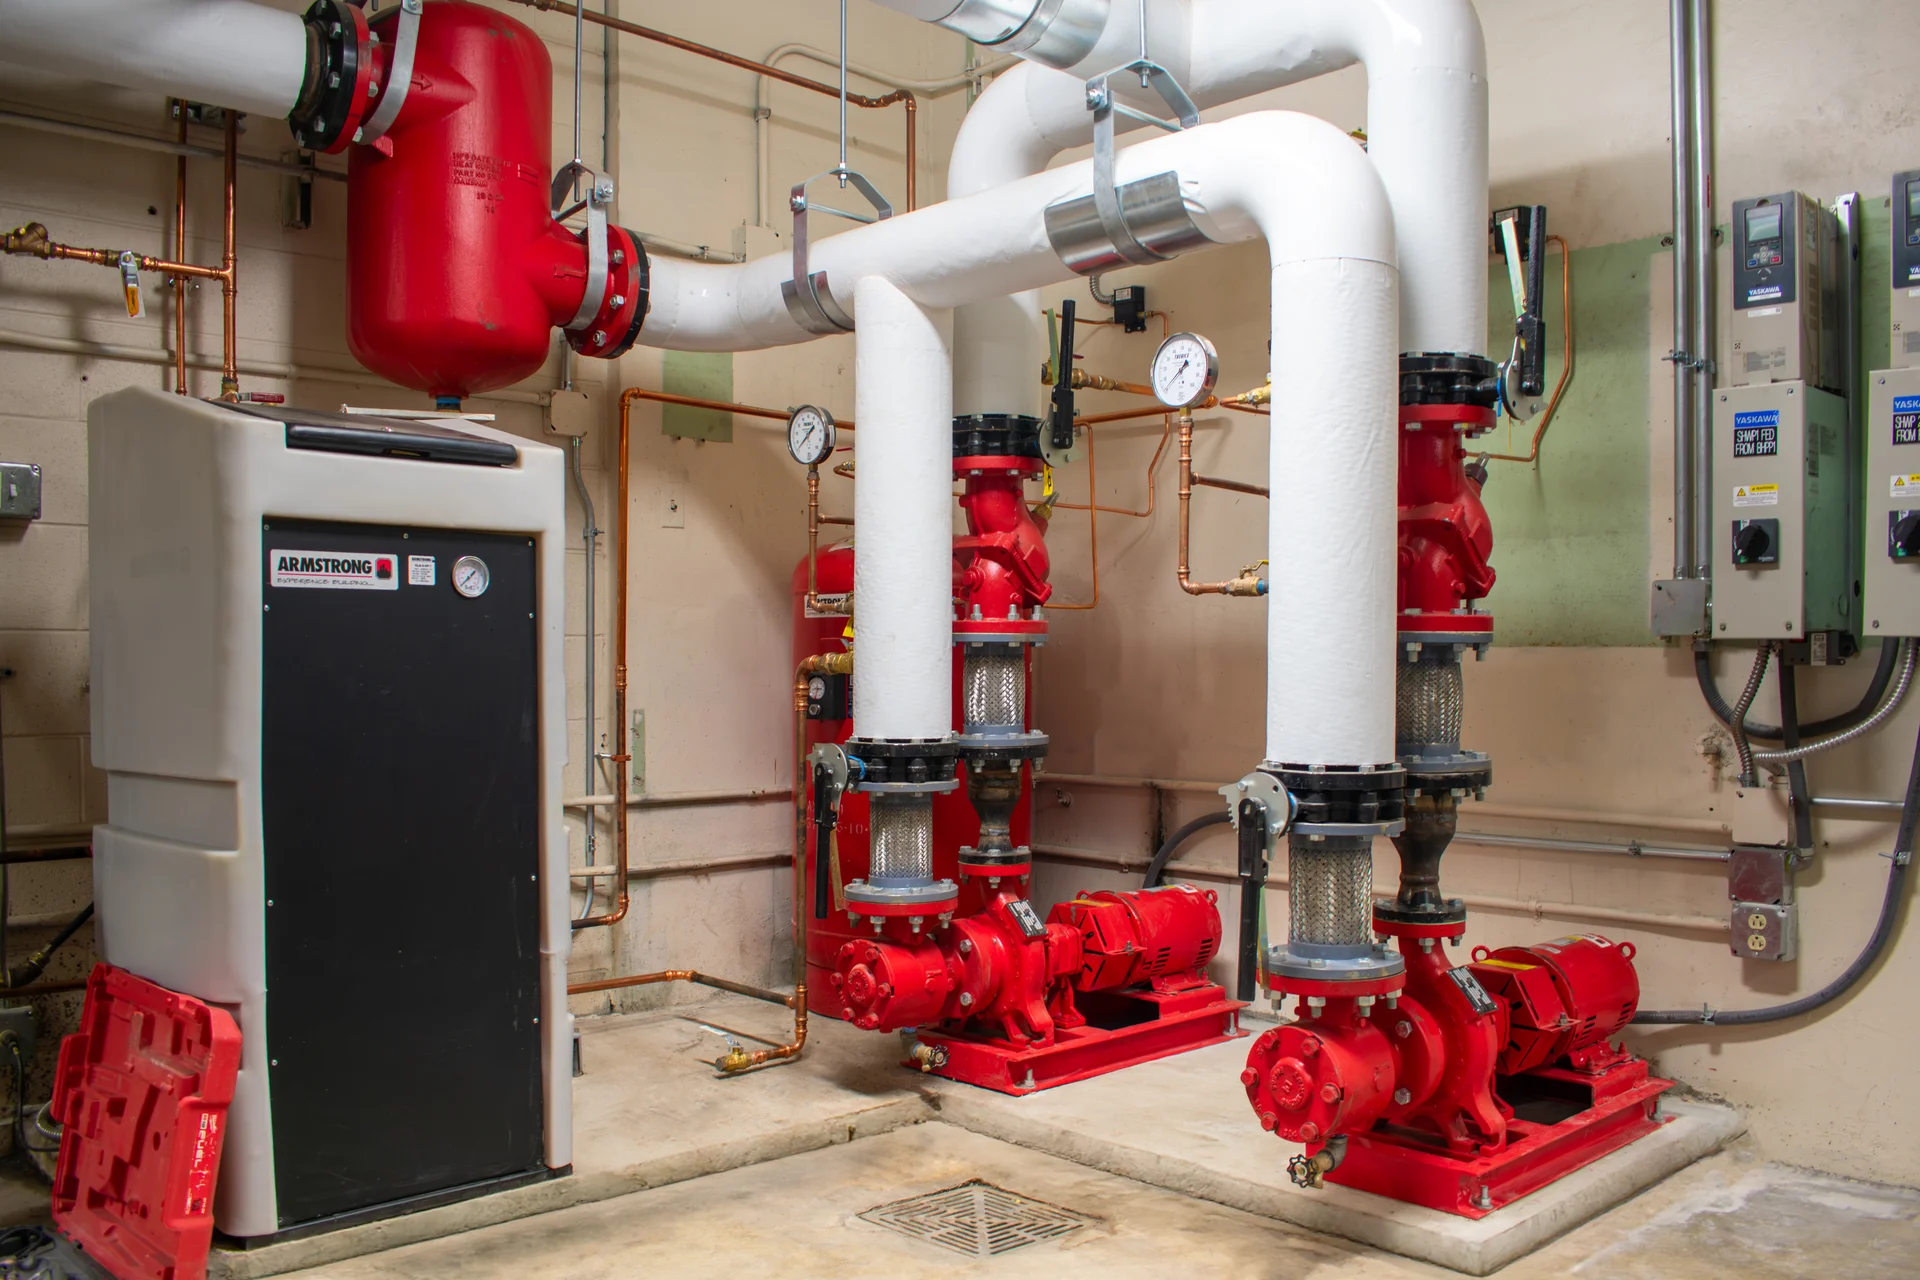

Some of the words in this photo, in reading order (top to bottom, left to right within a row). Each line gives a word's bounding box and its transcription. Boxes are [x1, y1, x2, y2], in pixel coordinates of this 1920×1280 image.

[1749, 286, 1780, 296] YASKAWA
[1736, 415, 1778, 424] YASKAWA
[1761, 428, 1775, 441] FED
[1895, 428, 1916, 442] FROM
[1735, 442, 1755, 455] FROM
[278, 556, 372, 574] ARMSTRONG
